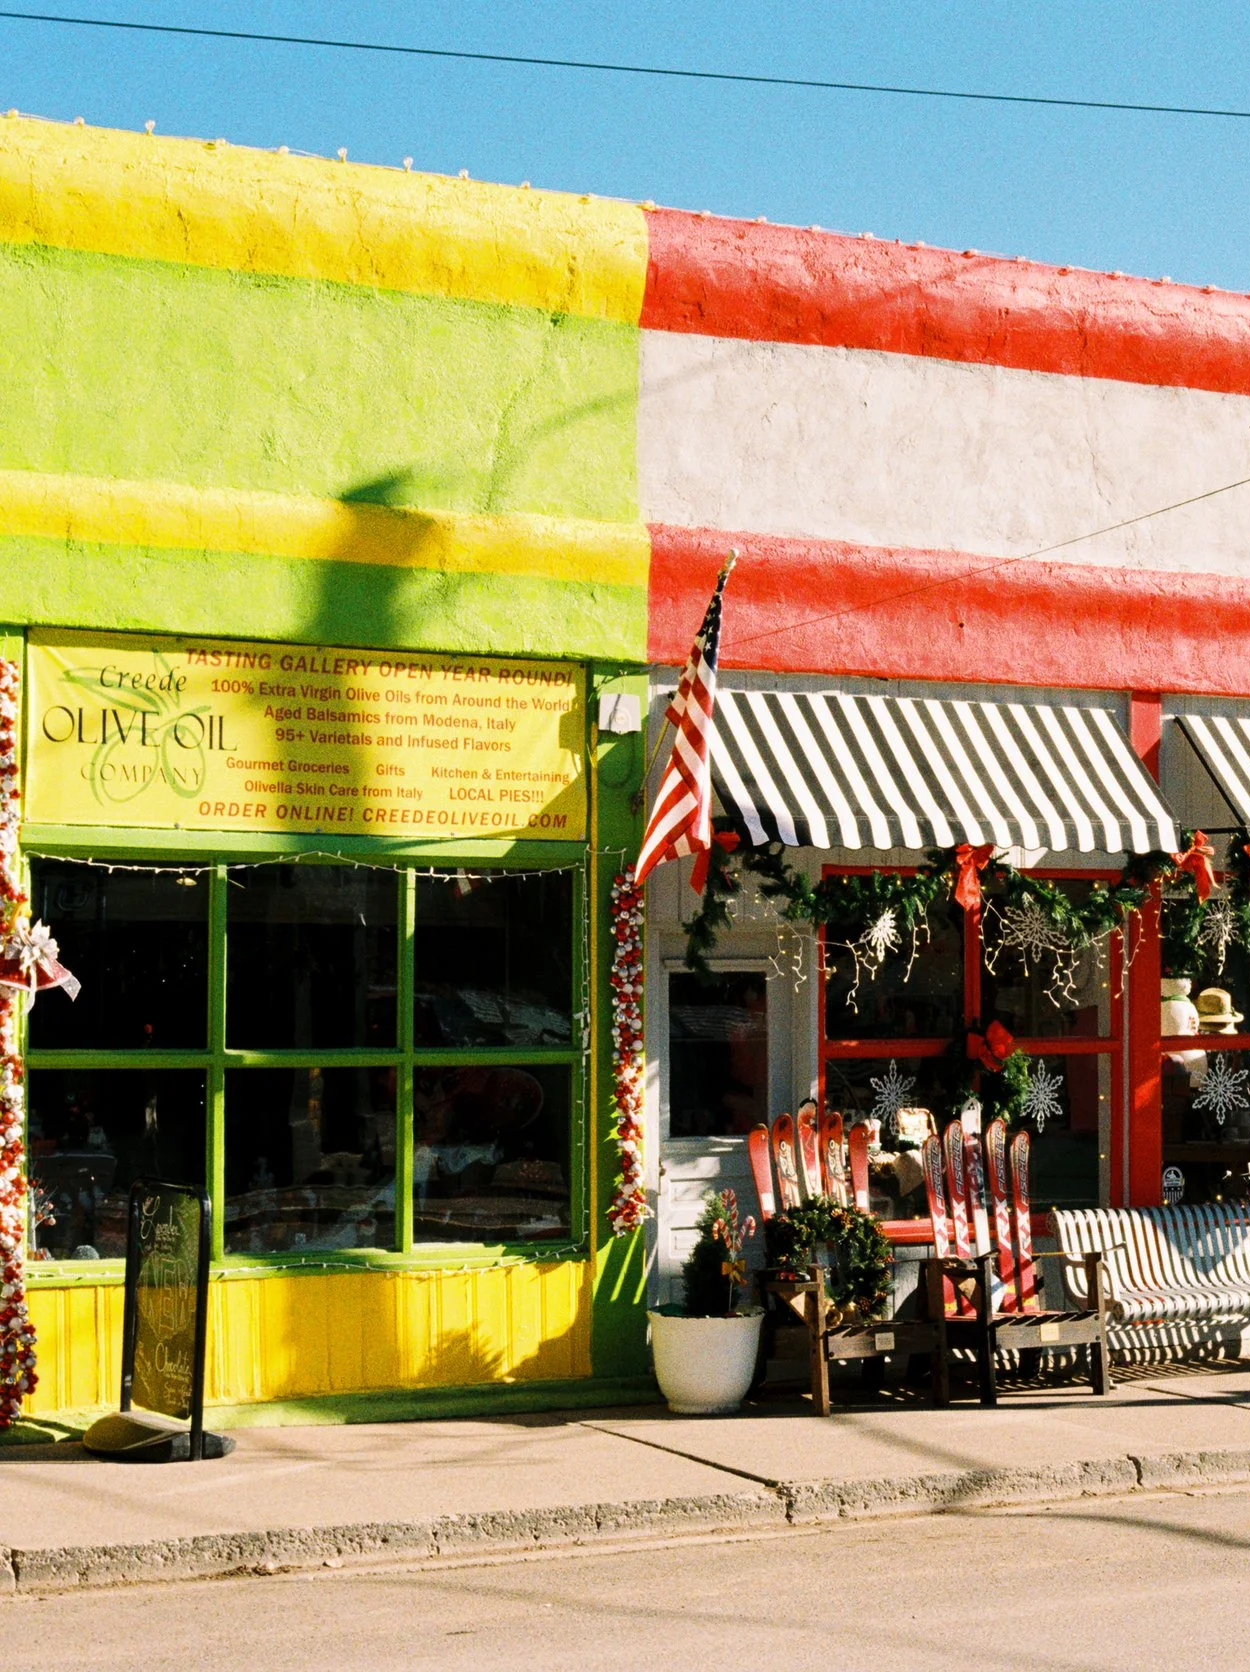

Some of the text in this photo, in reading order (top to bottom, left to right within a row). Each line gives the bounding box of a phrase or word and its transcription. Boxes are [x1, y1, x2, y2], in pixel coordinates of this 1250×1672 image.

[100, 665, 187, 693] Creede
[186, 648, 573, 687] TASTING GALLERY OPEN YEAR ROUND!
[211, 679, 570, 712] 100% Extra Virgin Olive Oils from Around the World
[42, 705, 238, 752] OLIVE OIL
[264, 705, 516, 732] Aged Balsamics from Modena, Italy
[275, 728, 511, 752] 95+ Varietals and Infused Flavors
[81, 762, 204, 785] COMPANY
[226, 757, 350, 775] Gourmet Groceries
[376, 763, 405, 777] Gifts
[431, 766, 570, 785] Kitchen & Entertaining
[244, 780, 423, 800] Olivella Skin Care from Italy
[449, 787, 545, 803] LOCAL PIES!!!
[199, 801, 568, 829] ORDER ONLINE! CREEDEOLIVEOIL.COM
[930, 1140, 945, 1210] FISCHER
[953, 1128, 965, 1196] FISCHER
[995, 1128, 1006, 1194] FISCHER
[1018, 1139, 1029, 1207] FISCHER
